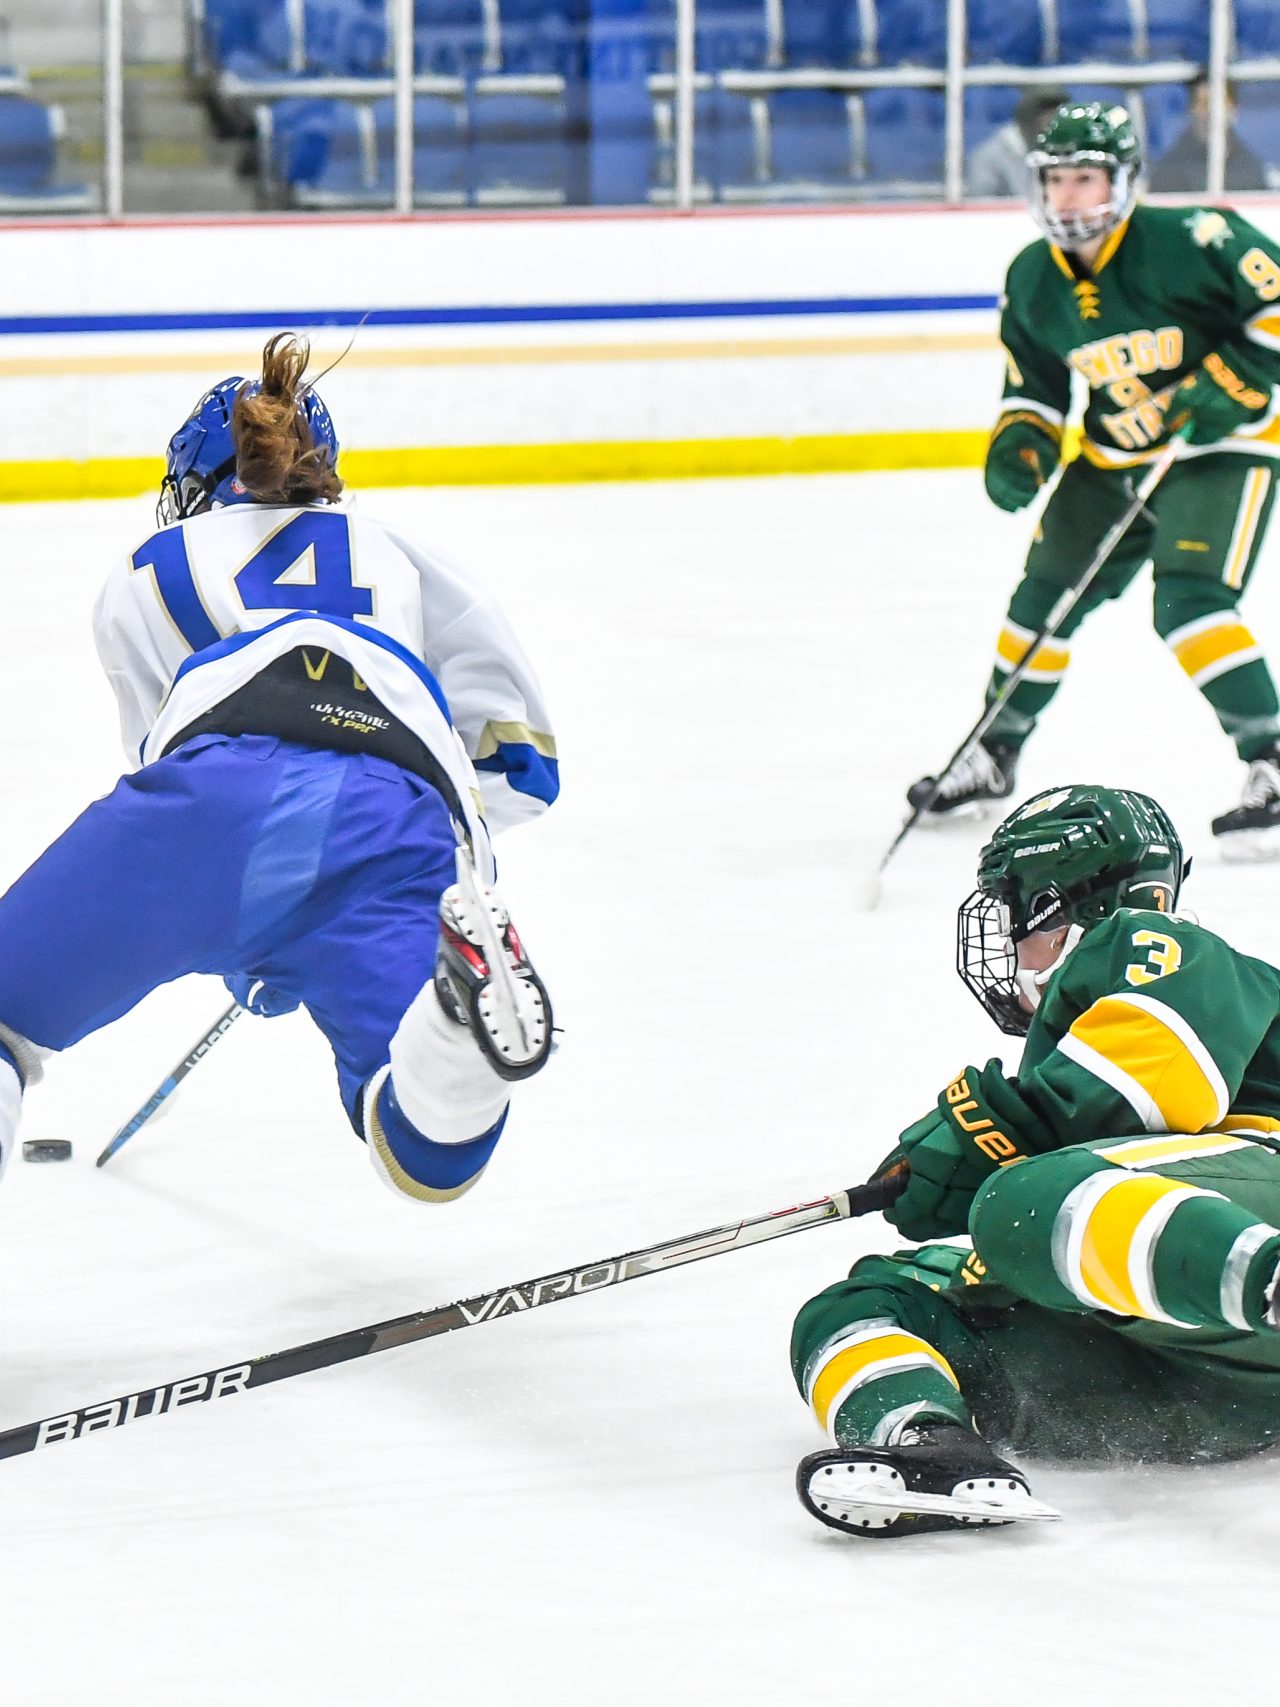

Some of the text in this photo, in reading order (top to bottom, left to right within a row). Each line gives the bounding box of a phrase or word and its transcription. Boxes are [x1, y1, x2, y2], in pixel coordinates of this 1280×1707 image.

[127, 508, 377, 653] 14
[1013, 842, 1061, 858] BAUER
[1026, 899, 1062, 931] BAUER
[1125, 929, 1183, 987] 3
[946, 1070, 1028, 1168] AUE
[33, 1363, 252, 1451] BAUER
